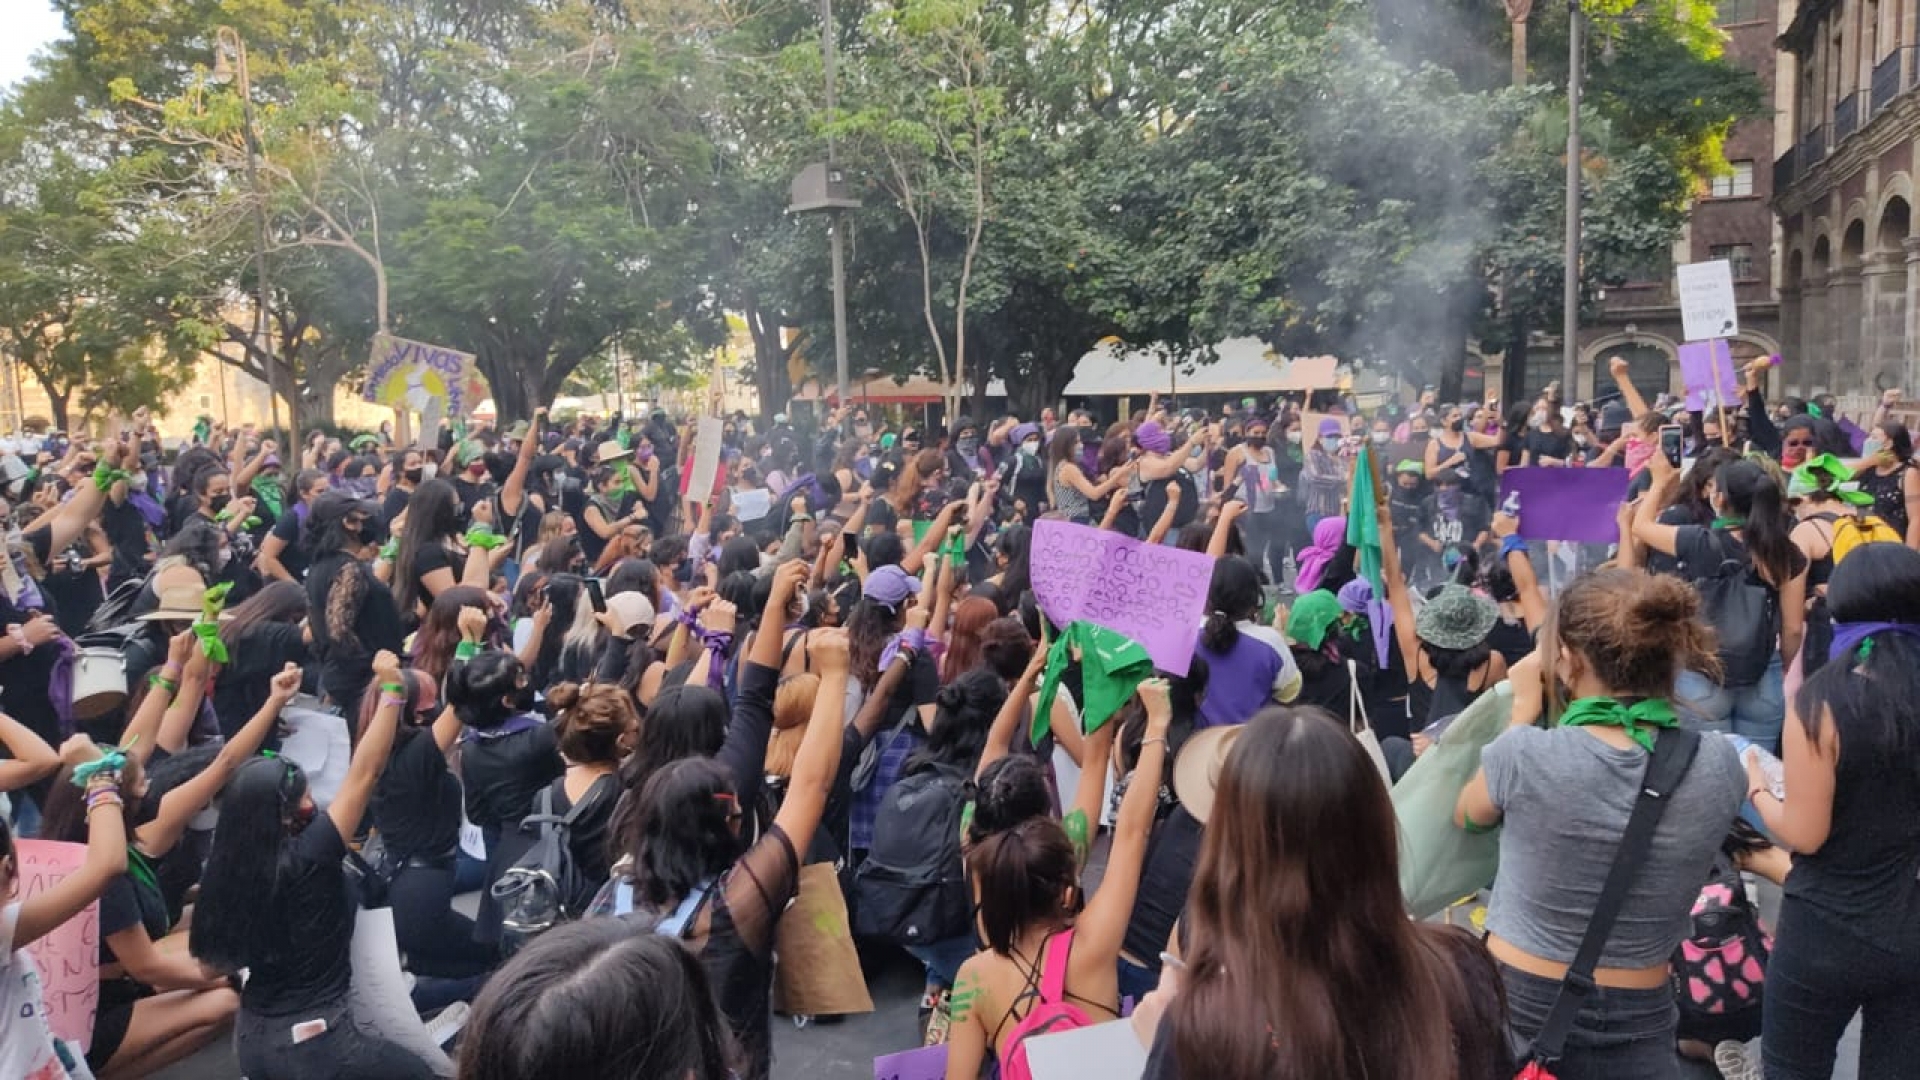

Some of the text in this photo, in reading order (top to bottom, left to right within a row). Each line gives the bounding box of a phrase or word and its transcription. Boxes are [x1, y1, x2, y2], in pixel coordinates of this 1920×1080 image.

[1036, 525, 1063, 546] No
[1071, 533, 1108, 556] nos
[1115, 546, 1178, 577] acusen
[1113, 564, 1160, 590] esto
[1082, 602, 1164, 630] somos
